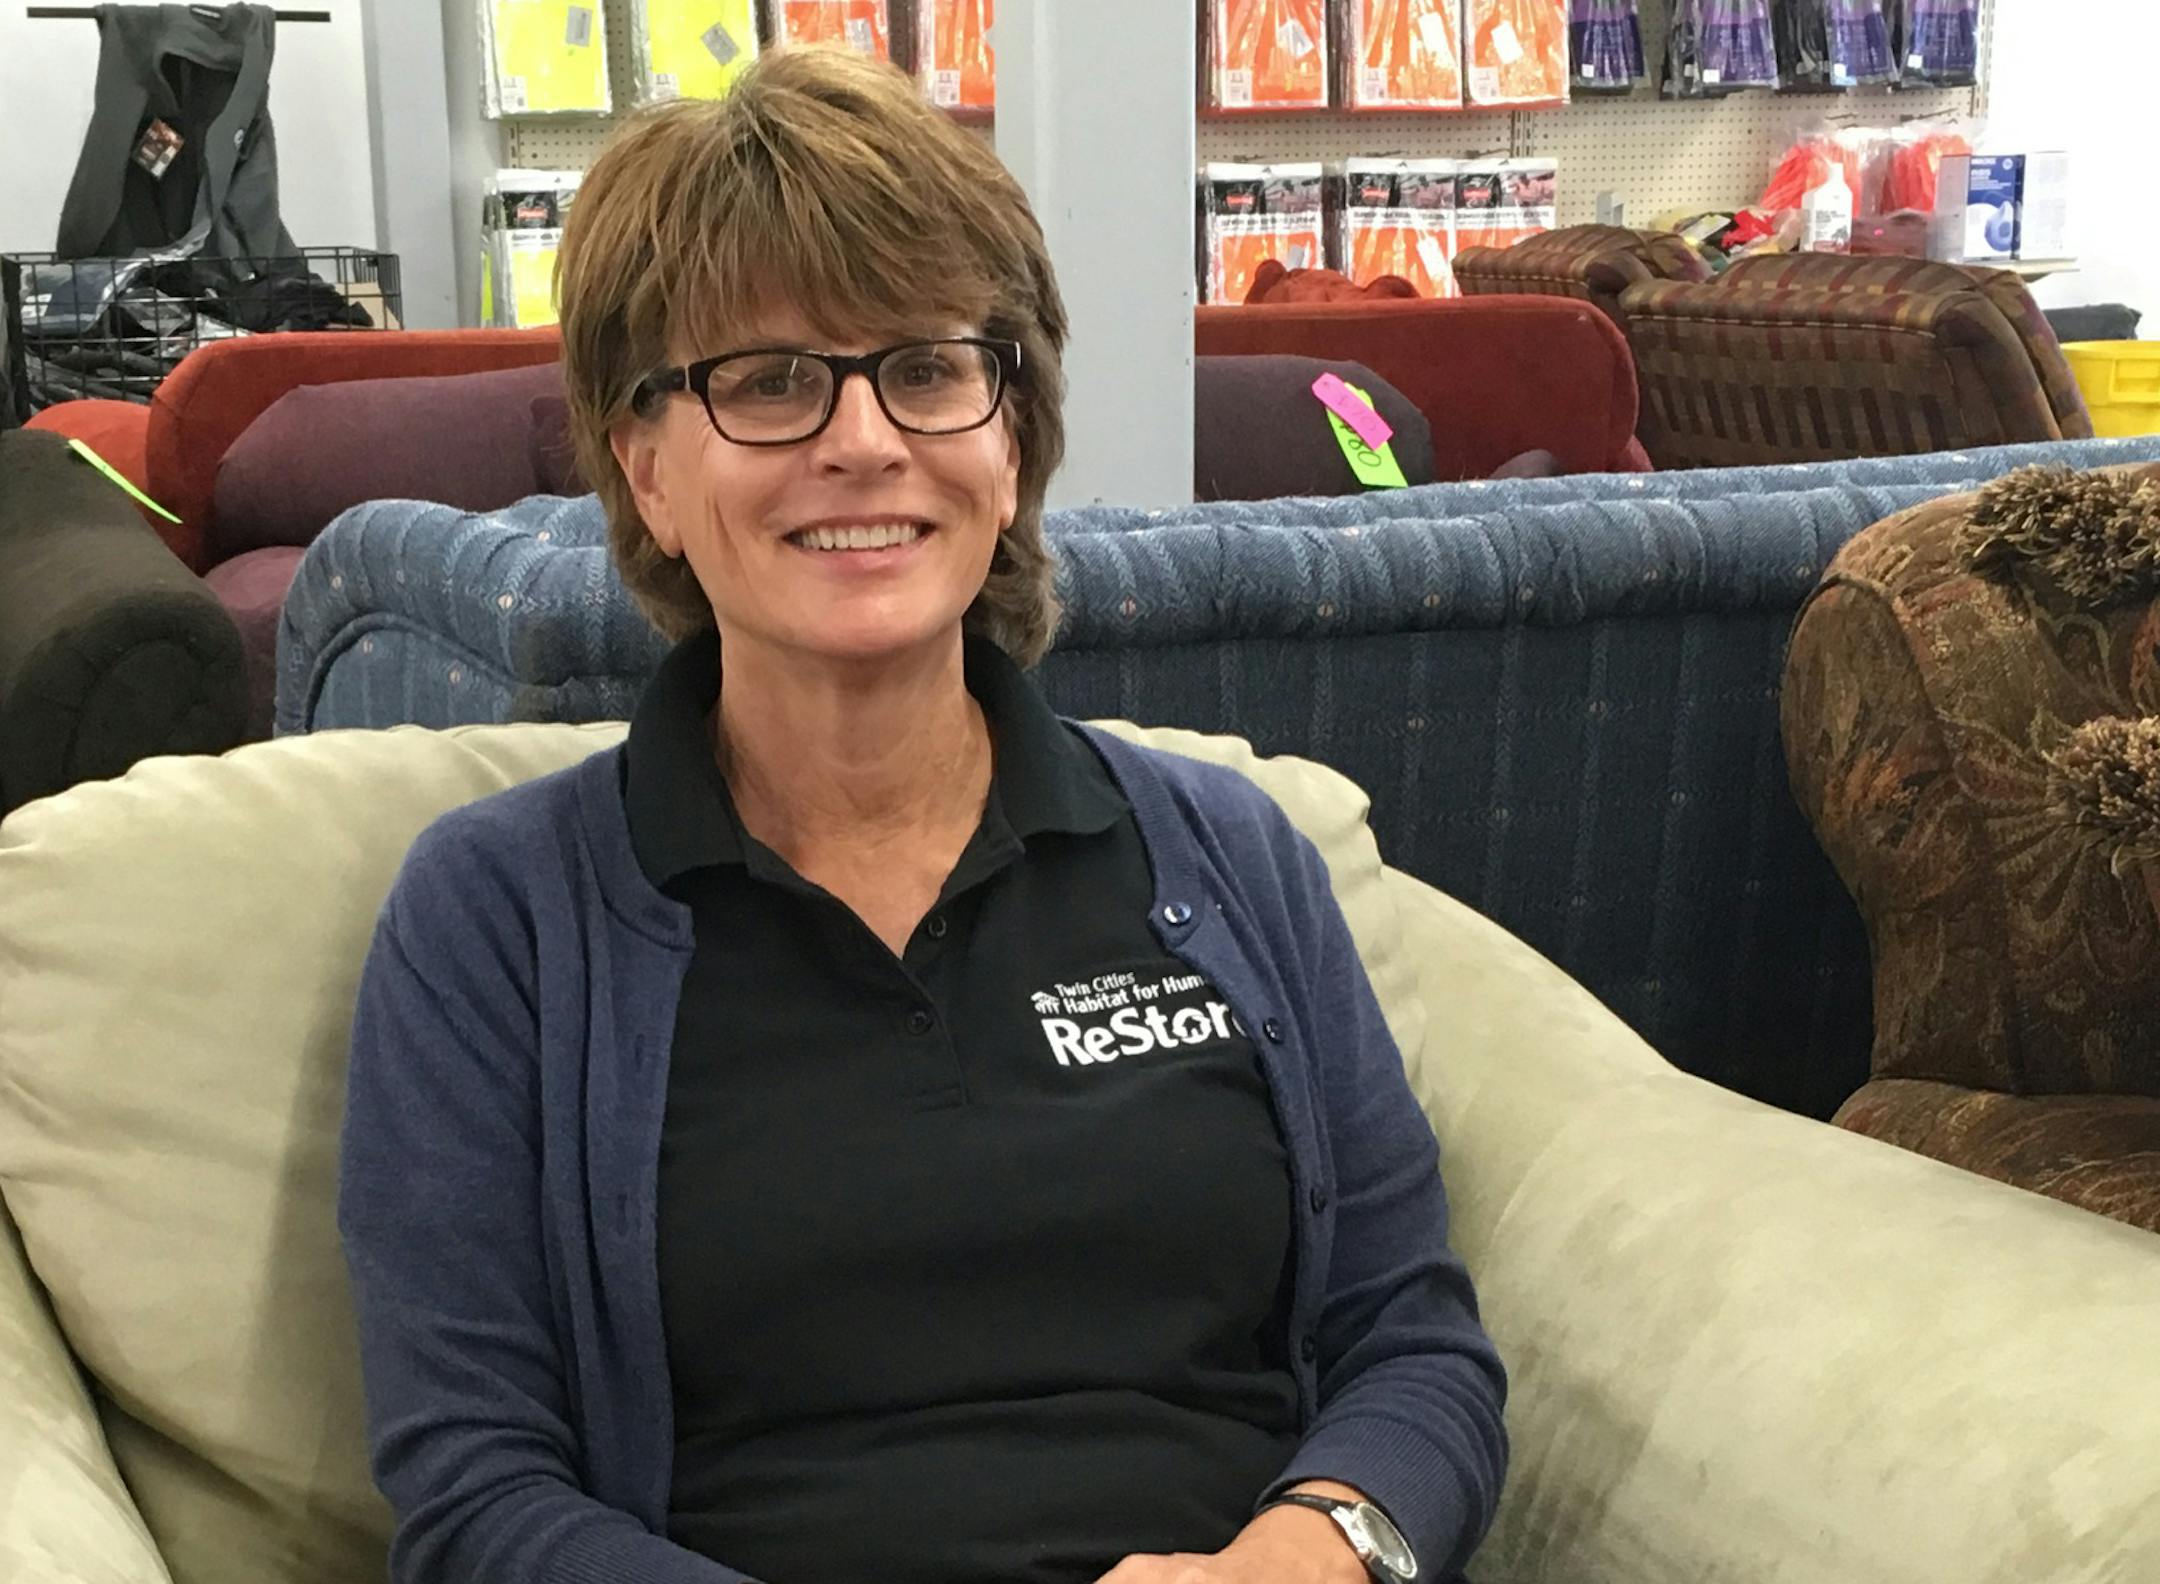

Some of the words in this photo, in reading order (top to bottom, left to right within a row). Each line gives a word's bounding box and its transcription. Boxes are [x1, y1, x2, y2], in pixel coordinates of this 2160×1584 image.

[1054, 983, 1091, 998] Twin
[1092, 971, 1136, 992] Cities
[1063, 988, 1130, 1015] Habitat
[1132, 983, 1160, 1001] for
[1161, 975, 1208, 995] Hum
[1040, 1001, 1248, 1067] ReStor
